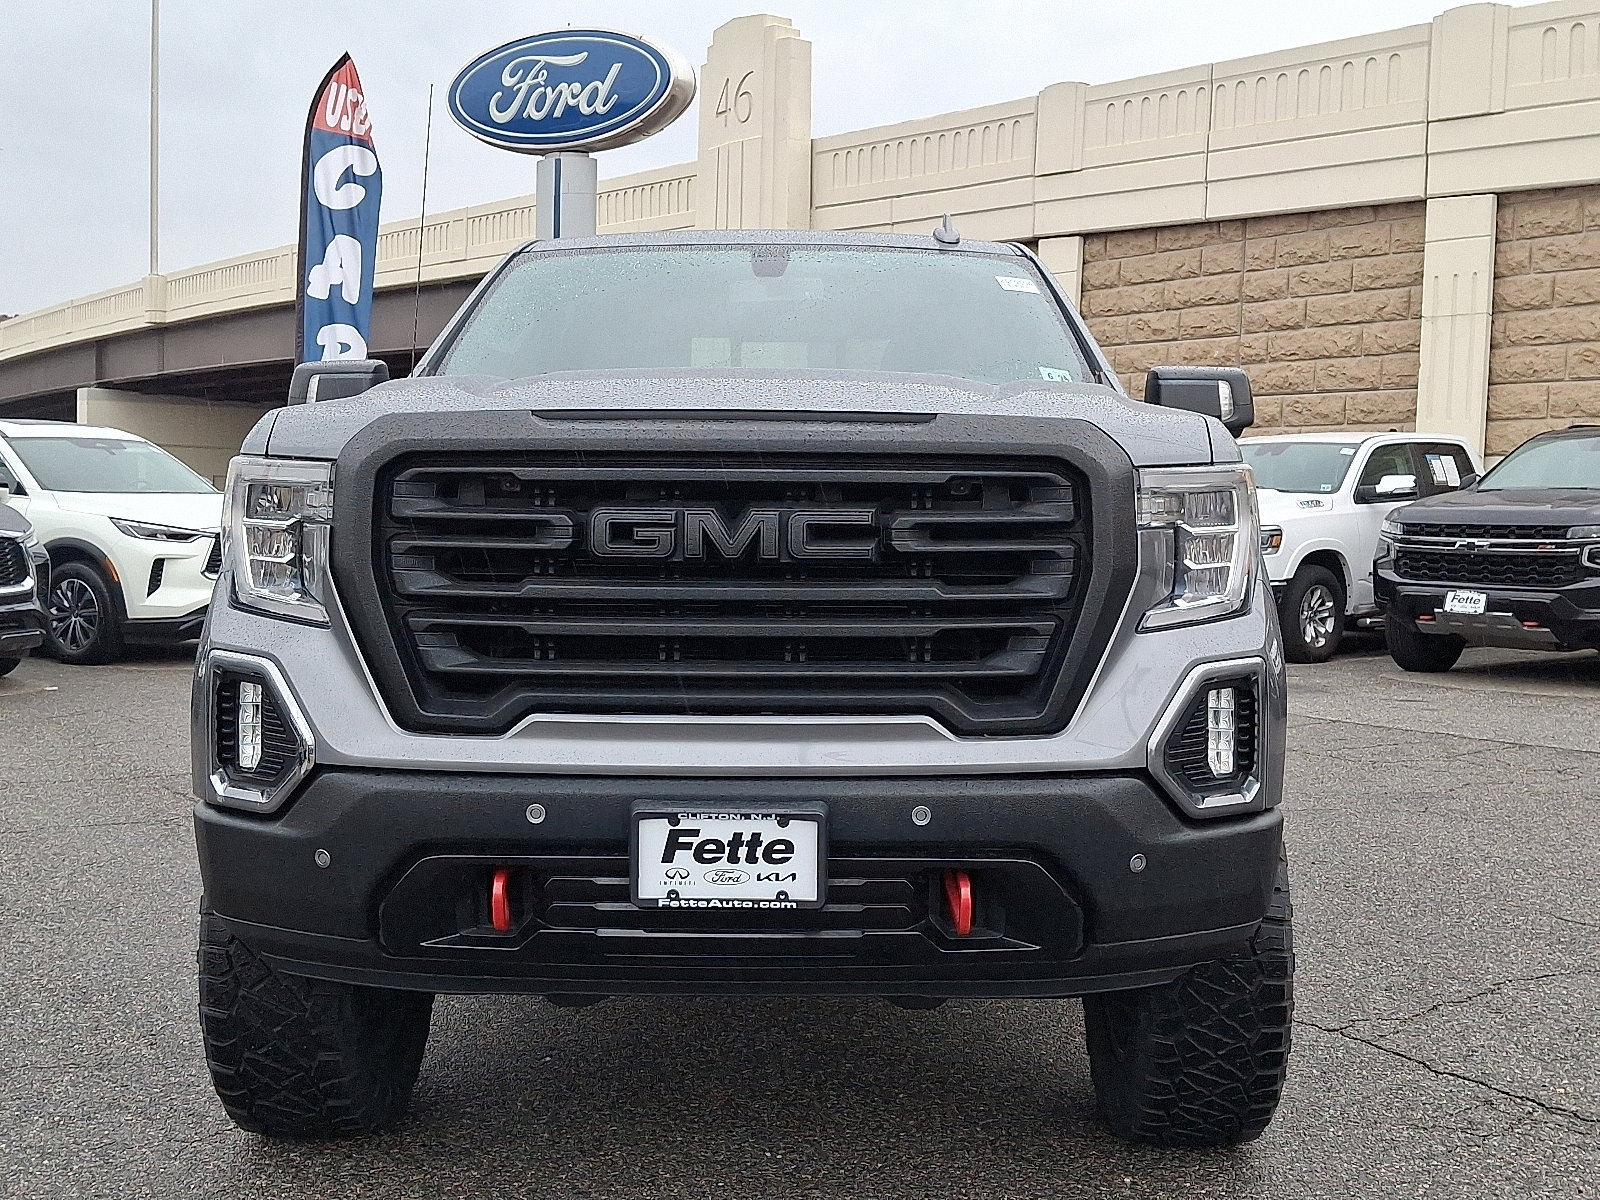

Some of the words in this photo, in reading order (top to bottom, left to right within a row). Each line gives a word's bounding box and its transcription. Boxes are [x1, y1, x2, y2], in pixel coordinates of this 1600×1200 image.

[489, 51, 622, 124] Ford
[716, 70, 754, 127] 46
[325, 81, 370, 136] USE
[591, 507, 876, 559] GMC
[1450, 594, 1481, 605] Fette
[750, 813, 781, 821] N.J.
[661, 828, 795, 865] Fette
[711, 870, 742, 883] Ford
[657, 899, 797, 909] FetteAuto.com
